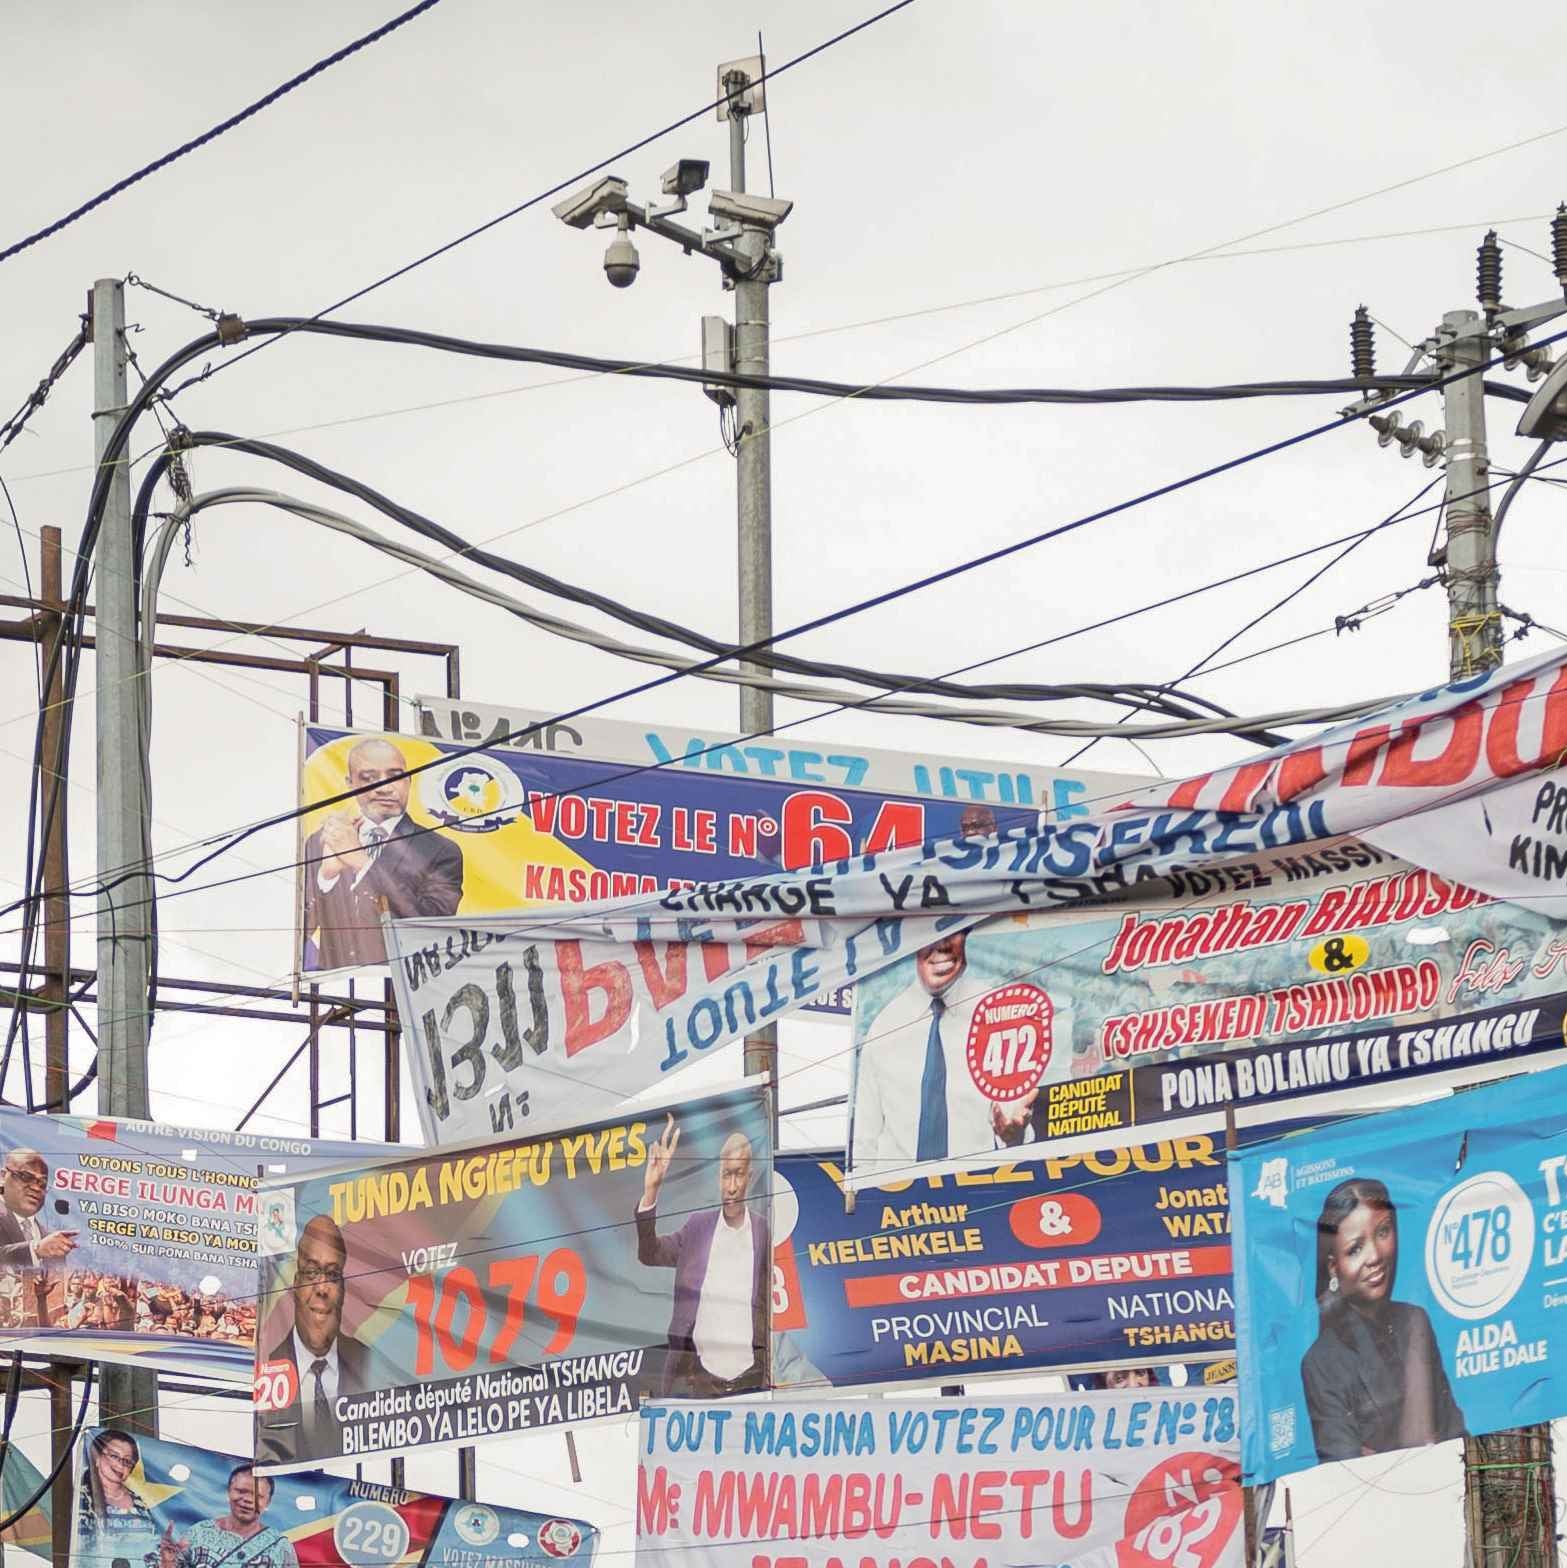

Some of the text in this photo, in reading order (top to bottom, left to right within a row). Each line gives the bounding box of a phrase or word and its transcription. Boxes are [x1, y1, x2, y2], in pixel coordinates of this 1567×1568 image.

[528, 789, 661, 849] VOTEZ
[672, 810, 717, 855] LE
[1102, 898, 1306, 976] Jonathan
[1100, 959, 1440, 1061] TSHISEKEDI TSHILOMBO
[981, 1025, 1038, 1078] 472
[1161, 1009, 1541, 1112] PONA BOLAMU YA TSHANGU
[54, 1169, 227, 1212] SERGE ILUNGA
[328, 1121, 649, 1226] TUNDA NGIEFU YVES
[808, 1228, 984, 1268] KIELENKELE
[1450, 1204, 1511, 1270] 478
[899, 1250, 1193, 1299] CANDIDAT DEPUTE
[404, 1247, 587, 1377] 1079
[871, 1304, 1048, 1343] PROVINCIAL
[1456, 1320, 1517, 1357] ALDA
[903, 1335, 1023, 1367] MASINA
[335, 1349, 644, 1424] Candidat député National TSHANGU
[639, 1405, 1097, 1459] TOUT MASINA VOTEZ POUR
[692, 1467, 1094, 1542] MWAMBU-NETU
[344, 1516, 402, 1559] 229
